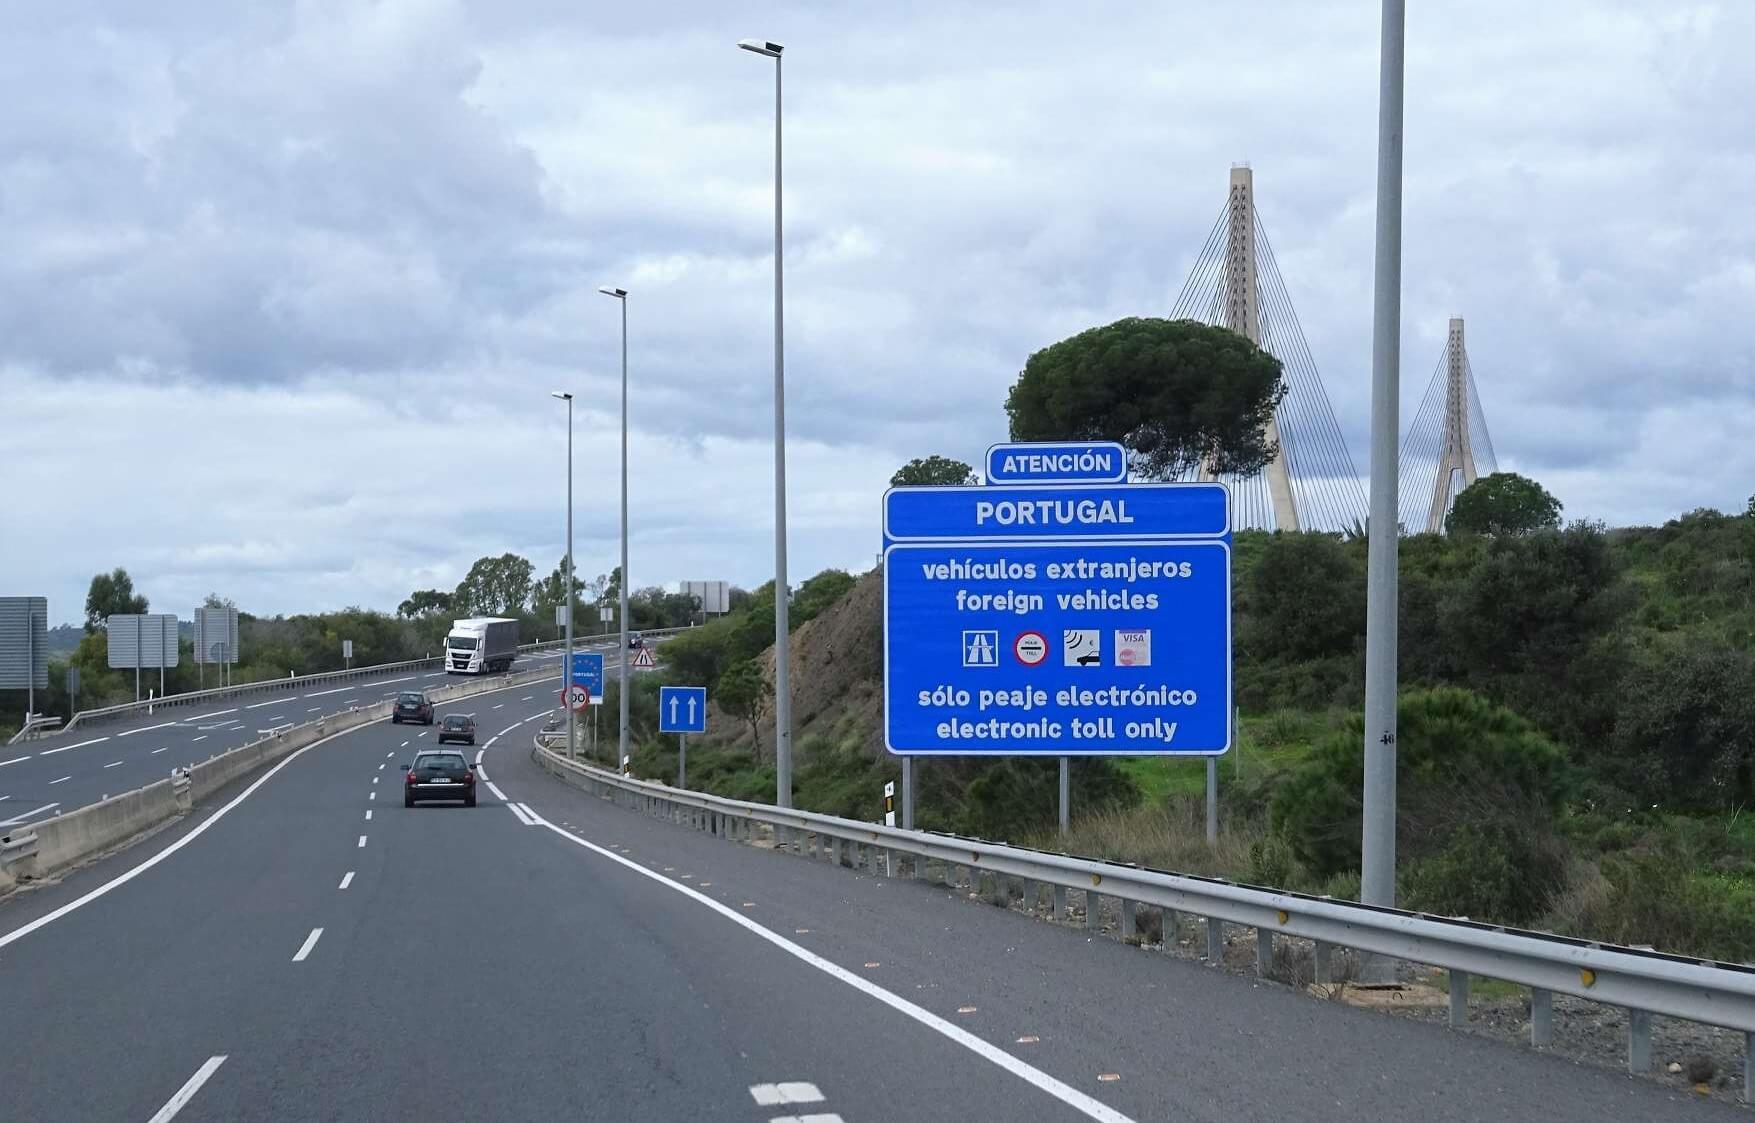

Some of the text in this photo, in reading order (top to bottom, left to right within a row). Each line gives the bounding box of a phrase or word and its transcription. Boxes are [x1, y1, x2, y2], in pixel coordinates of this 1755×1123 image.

[1003, 450, 1110, 472] ATENCIÓN
[977, 500, 1133, 524] PORTUGAL
[923, 557, 1191, 582] vehículos extranjeros
[956, 589, 1158, 614] foreign vehicles
[1123, 634, 1145, 642] VISA
[918, 685, 1197, 710] sólo peaje electrónico
[936, 718, 1177, 742] electronic toll only
